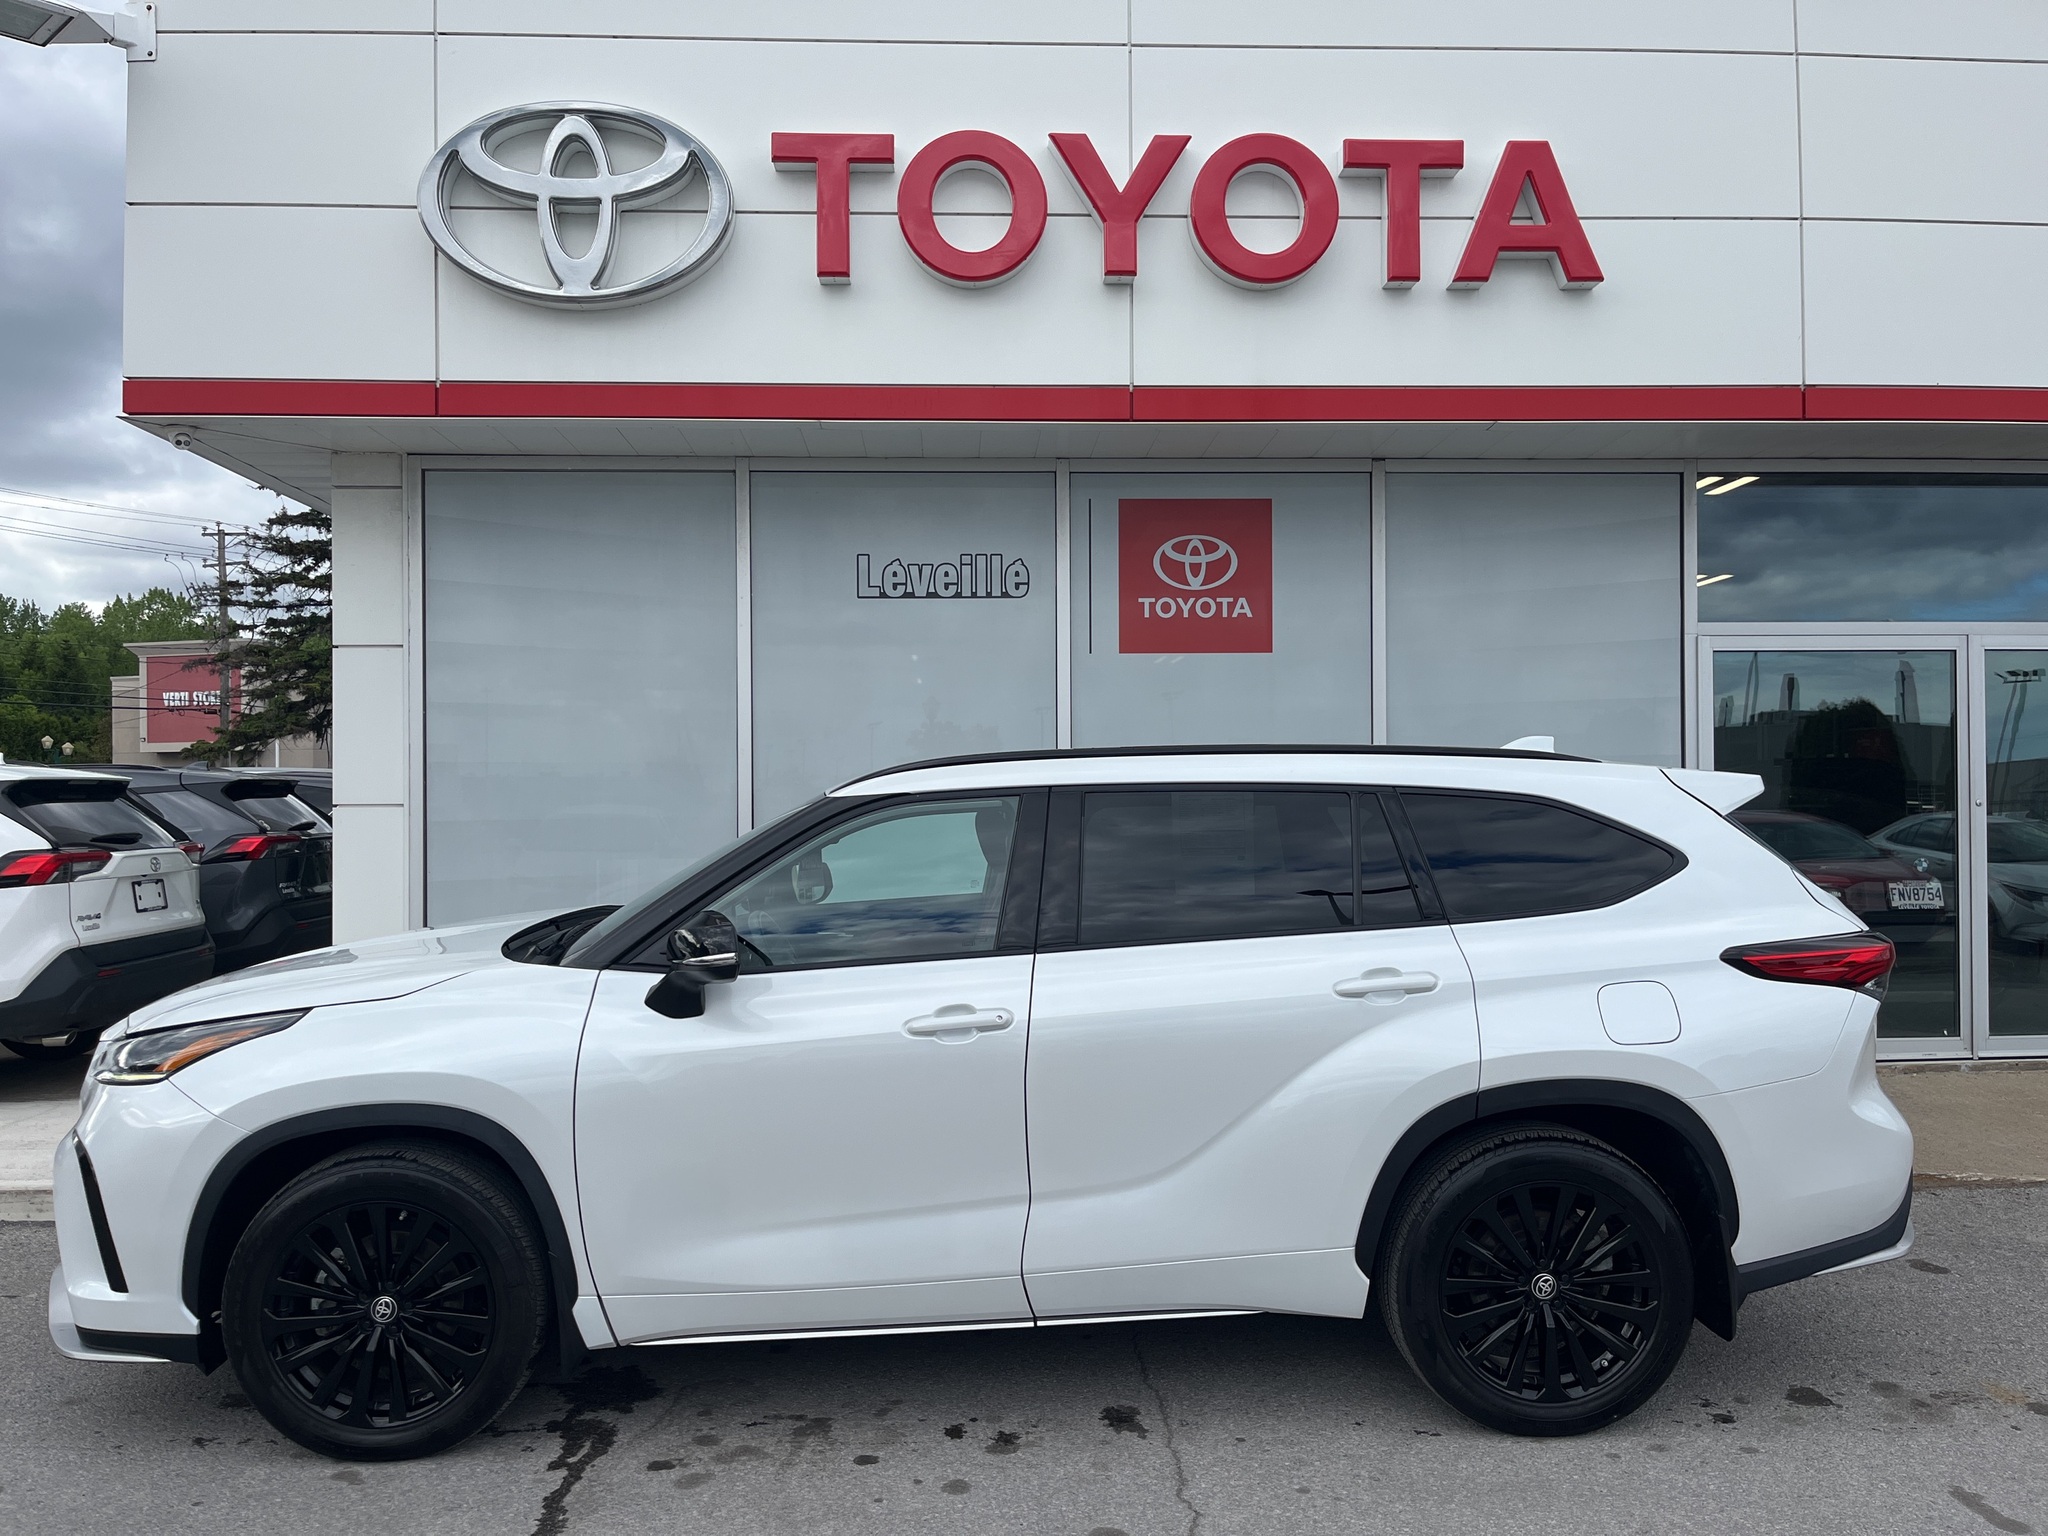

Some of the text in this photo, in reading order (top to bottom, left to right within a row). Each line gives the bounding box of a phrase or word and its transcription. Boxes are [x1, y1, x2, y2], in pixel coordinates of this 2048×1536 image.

[771, 129, 1604, 291] TOYOTA
[856, 553, 1030, 599] Léveillé
[1138, 597, 1253, 619] TOYOTA
[162, 691, 190, 707] VERTI
[1889, 887, 1942, 902] FNV8754
